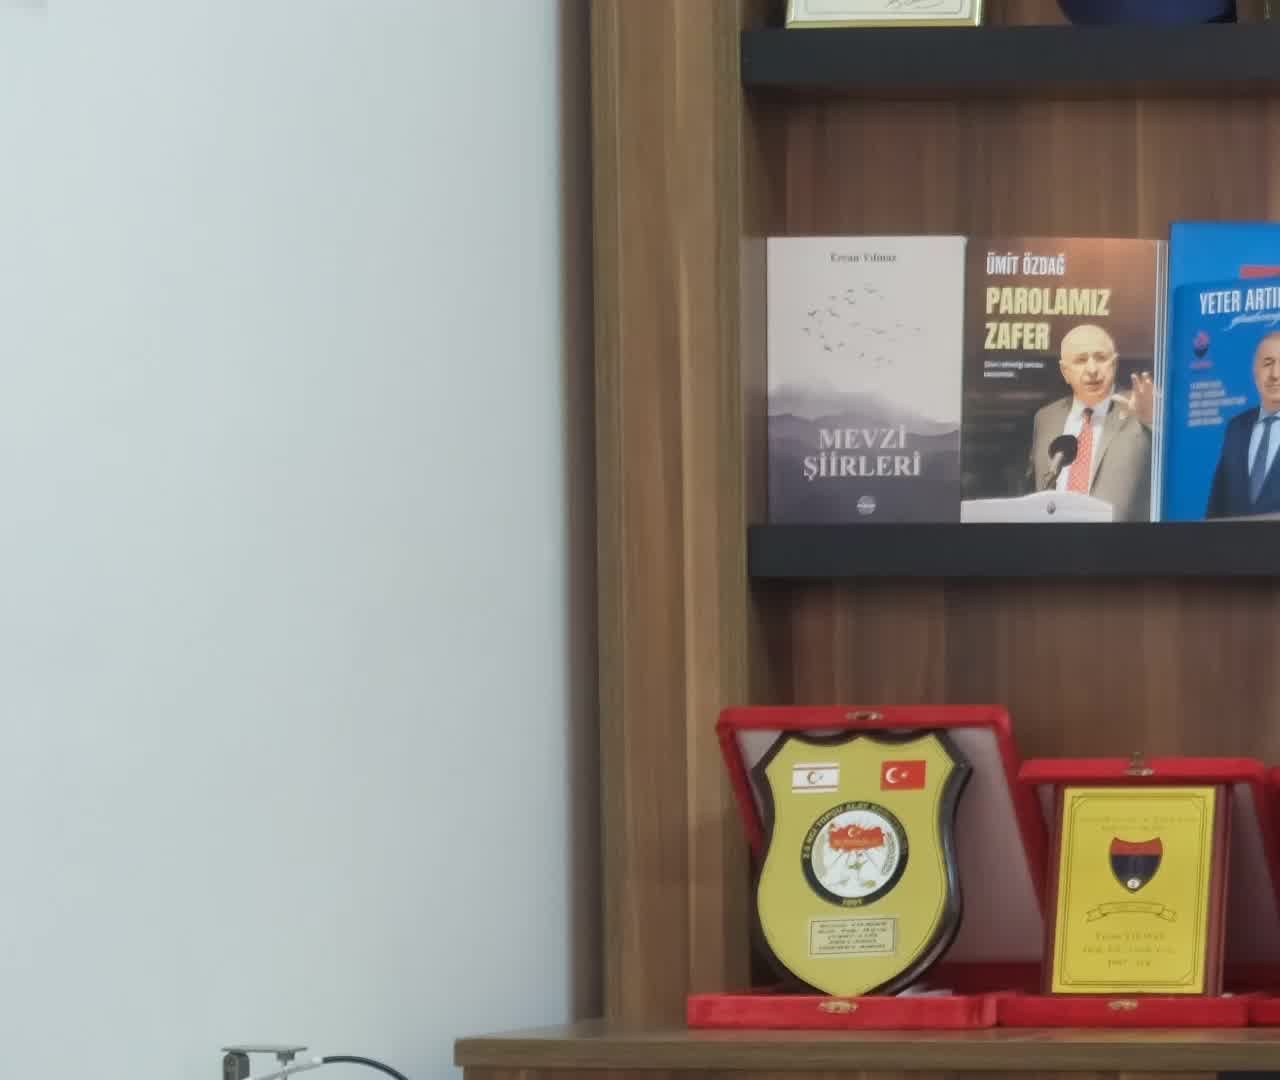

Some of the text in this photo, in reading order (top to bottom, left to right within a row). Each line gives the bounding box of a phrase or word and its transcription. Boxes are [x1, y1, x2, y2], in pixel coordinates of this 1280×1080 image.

[986, 251, 1066, 276] ÜMİT ÖZDAĞ
[985, 286, 1112, 317] PAROLAMIZ
[1199, 289, 1241, 316] YETER
[983, 321, 1050, 351] ZAFER
[818, 424, 906, 449] MEVZİ
[802, 450, 922, 482] ŞİİRLERİ
